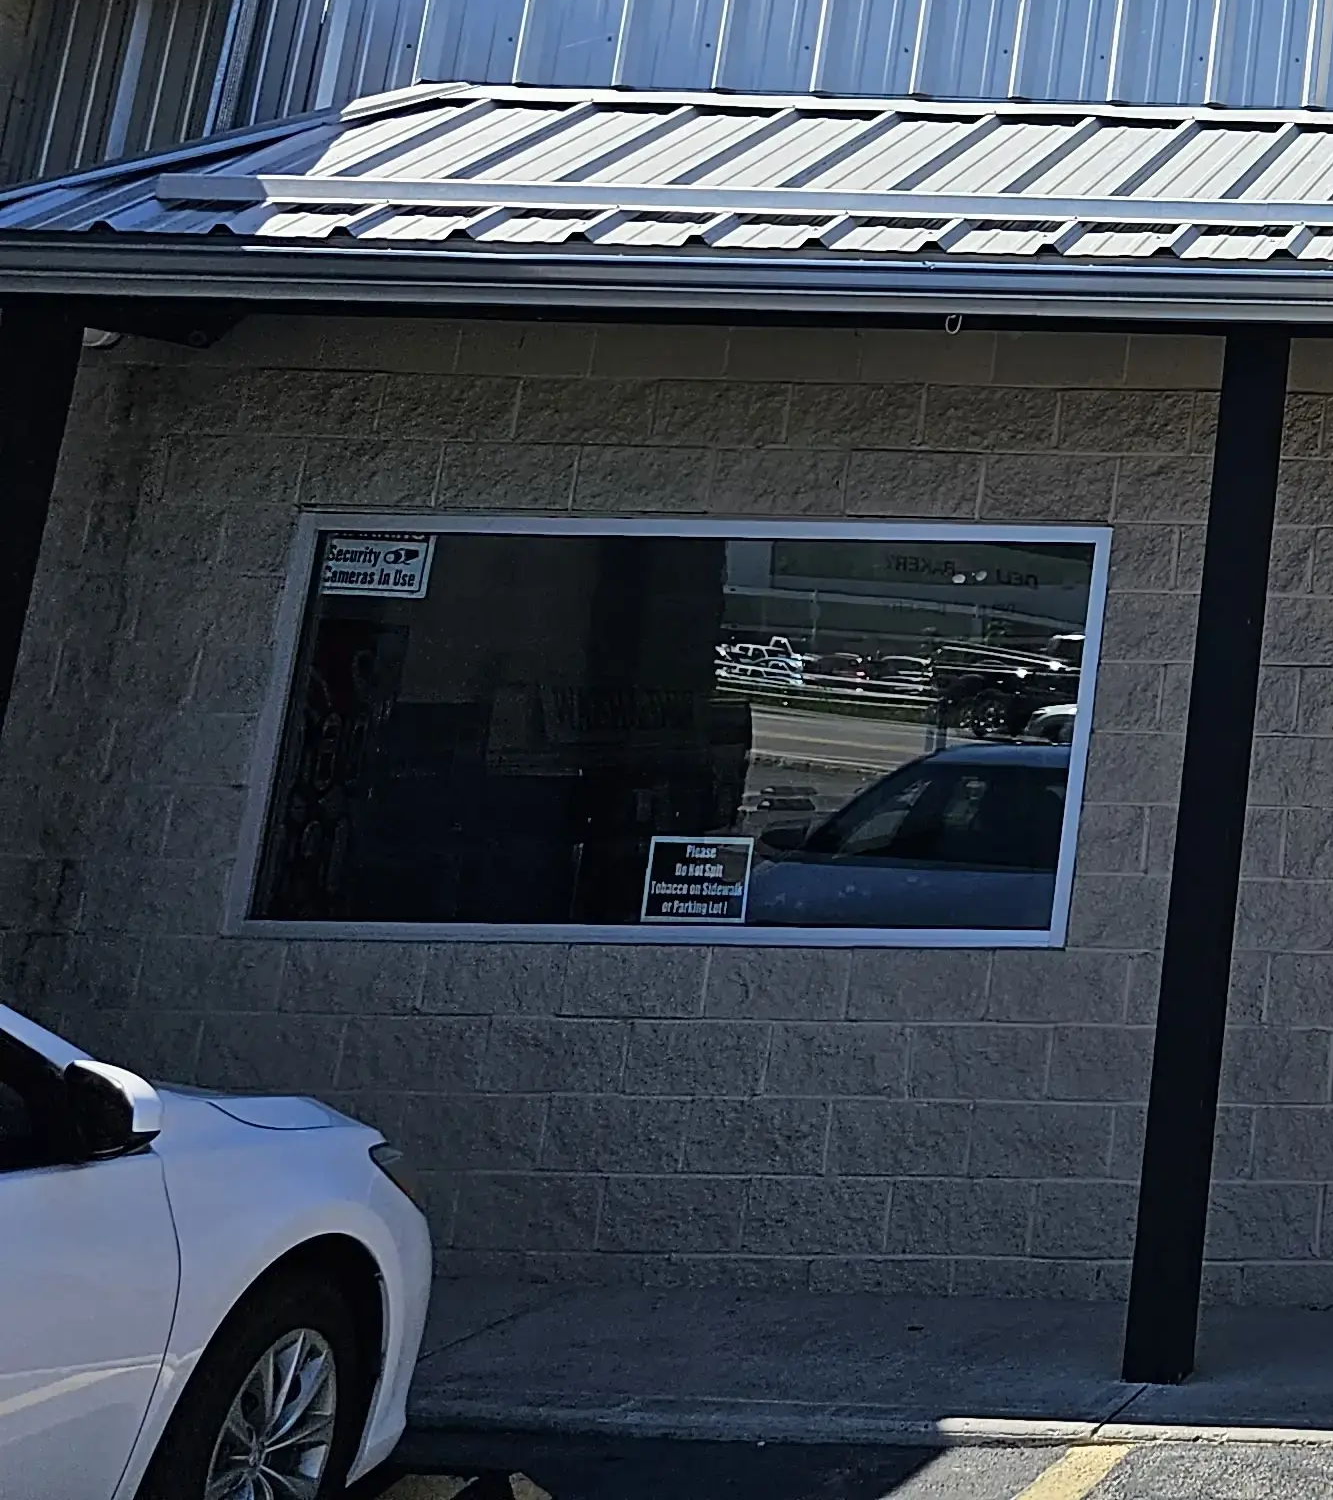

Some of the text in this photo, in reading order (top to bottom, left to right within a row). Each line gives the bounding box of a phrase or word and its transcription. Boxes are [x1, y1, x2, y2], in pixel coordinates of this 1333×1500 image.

[326, 545, 381, 567] Security
[323, 565, 416, 587] Cameras In Use
[686, 844, 717, 859] Please
[675, 863, 724, 878] Do Not Spit
[651, 880, 744, 897] Tobacco on Sidewalk
[662, 901, 672, 913] or
[673, 900, 708, 915] Parking
